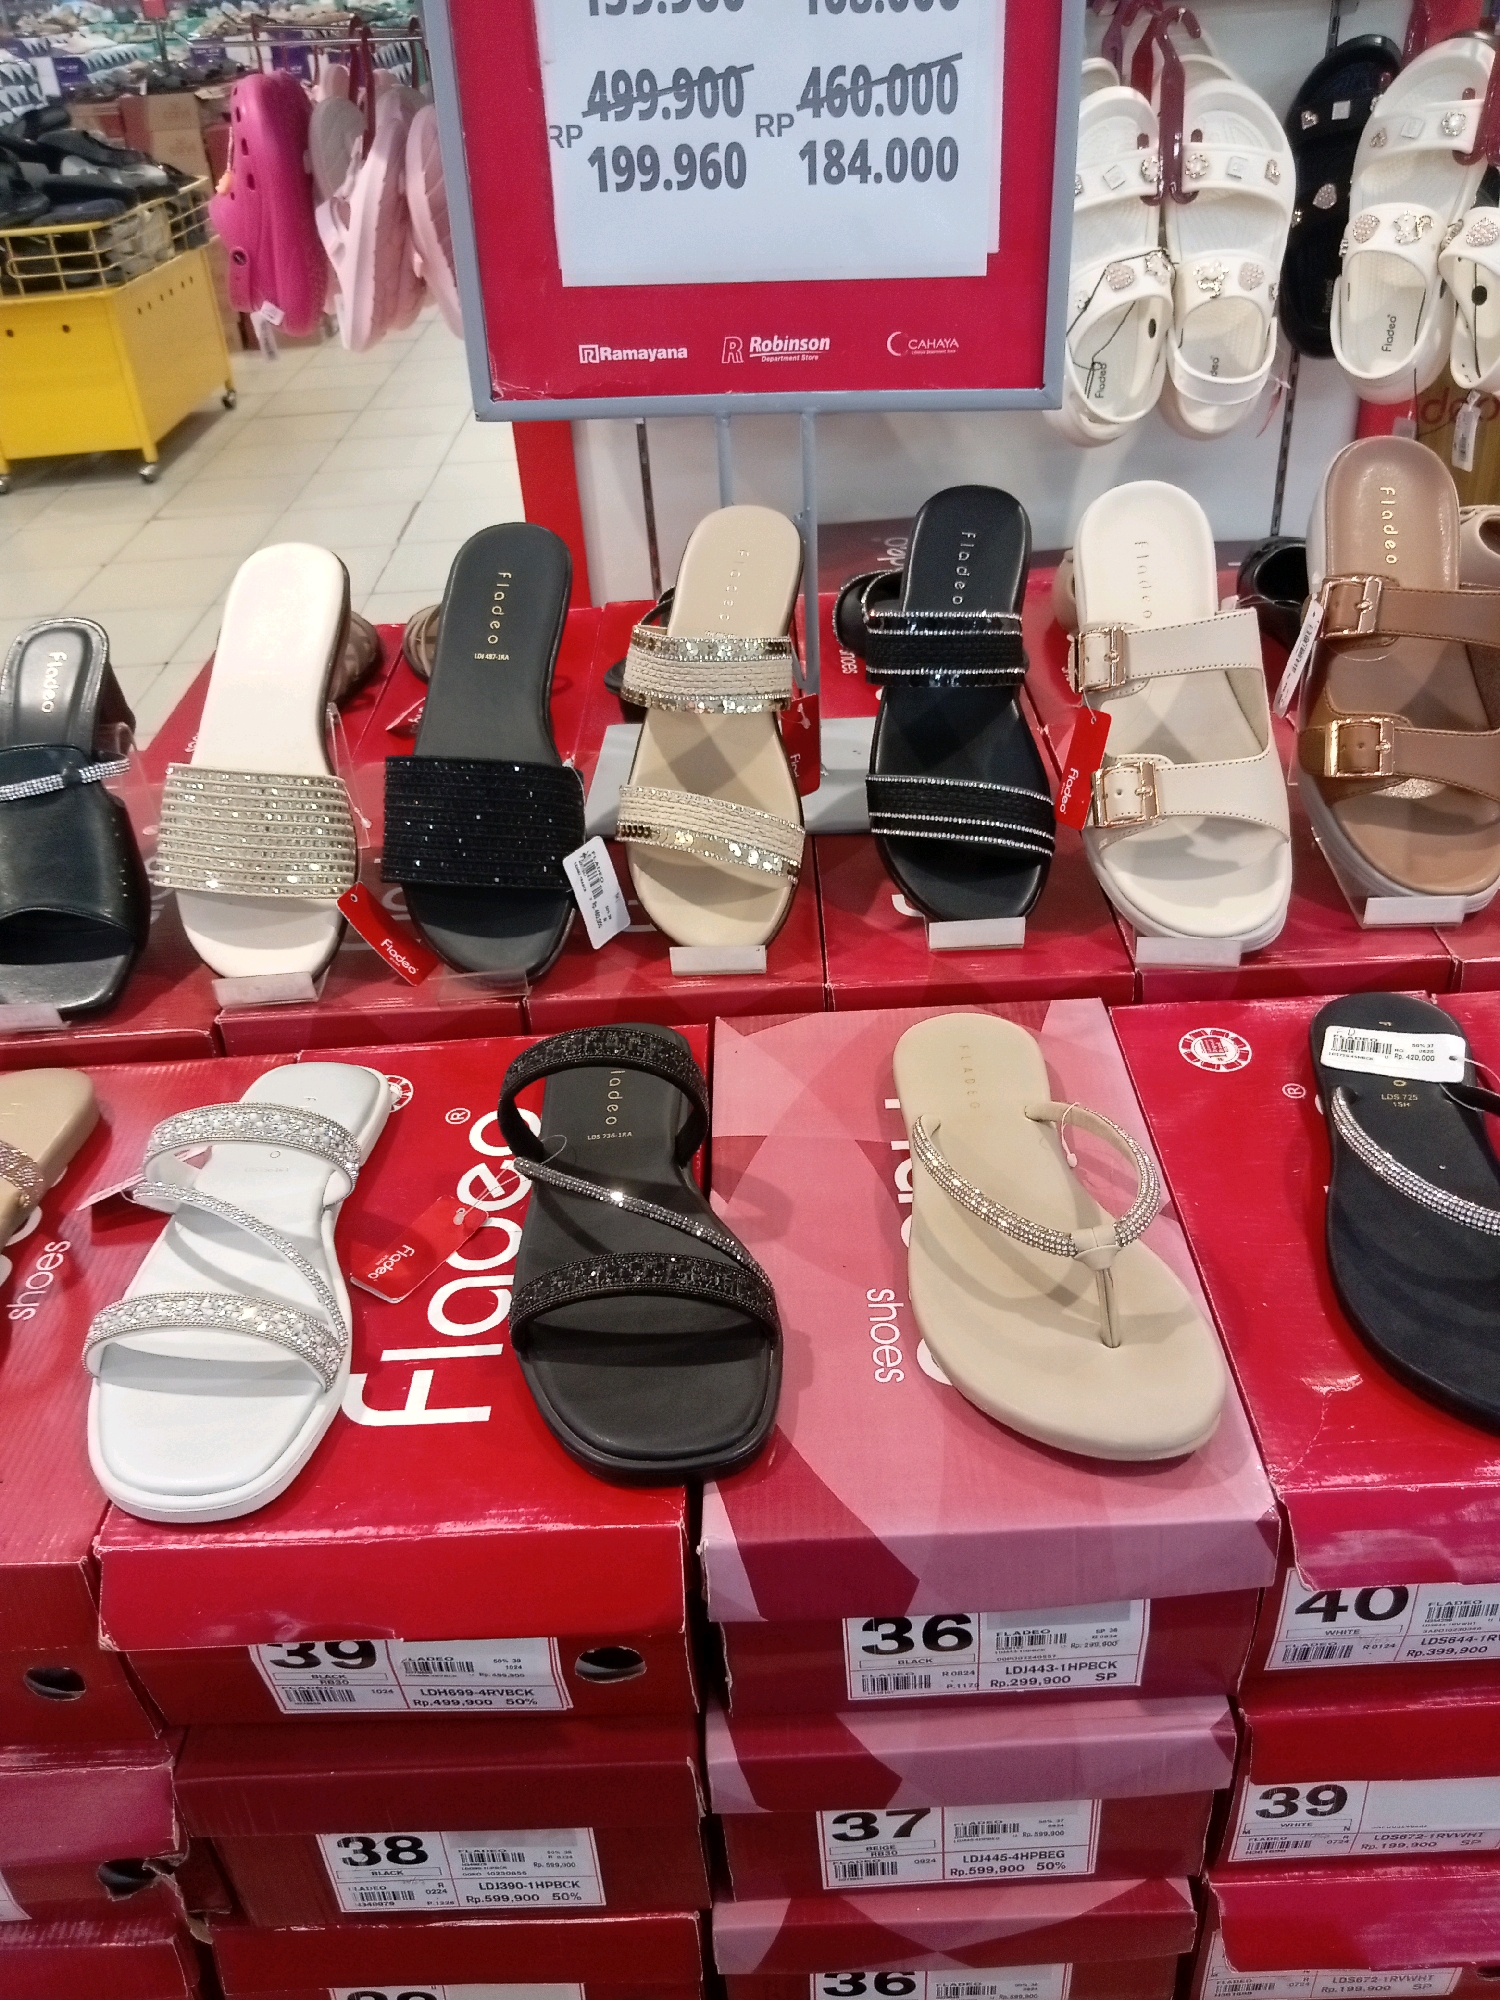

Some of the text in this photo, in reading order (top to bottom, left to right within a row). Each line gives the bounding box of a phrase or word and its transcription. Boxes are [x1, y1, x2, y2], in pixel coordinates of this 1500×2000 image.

[585, 65, 746, 122] 499.900
[799, 62, 960, 119] 460.000
[549, 124, 747, 193] RP 199.960
[755, 113, 959, 185] RP 184.000
[750, 335, 831, 352] Robinson
[908, 337, 959, 350] CAHAYA
[1382, 315, 1397, 352] Fladeo
[600, 346, 688, 362] Ramayana
[1380, 486, 1399, 564] Fladeo
[953, 531, 976, 605] Fladeo
[488, 572, 512, 645] Fladeo
[42, 651, 67, 713] Fladeo
[1060, 767, 1079, 813] Fladeo
[380, 938, 418, 975] Fladeo
[604, 1069, 626, 1125] ladeo
[368, 1244, 415, 1280] Fladeo
[7, 1240, 71, 1320] shoes
[866, 1288, 905, 1384] shoes
[1294, 1585, 1410, 1623] 40
[1427, 1599, 1483, 1607] FLADEO
[861, 1613, 974, 1655] 36
[1325, 1628, 1361, 1636] WHITE
[1420, 1634, 1500, 1647] LDS644-1R
[267, 1641, 377, 1671] 39
[1005, 1660, 1118, 1675] LDJ443-1HPBCK
[1406, 1646, 1488, 1659] Rp.399,900
[990, 1675, 1072, 1688] Rp.299,900
[1095, 1672, 1118, 1682] SP
[413, 1699, 493, 1707] Rp.499,900
[505, 1698, 538, 1706] 50%
[1255, 1784, 1348, 1819] 39
[832, 1807, 931, 1842] 37
[336, 1835, 429, 1867] 38
[963, 1849, 1066, 1864] LDJ445-4HPBEG
[1036, 1861, 1067, 1871] 50%
[950, 1864, 1026, 1877] Rp.599,900
[465, 1893, 540, 1905] Rp.599,900
[551, 1892, 582, 1901] 50%
[823, 1971, 917, 1997] 36
